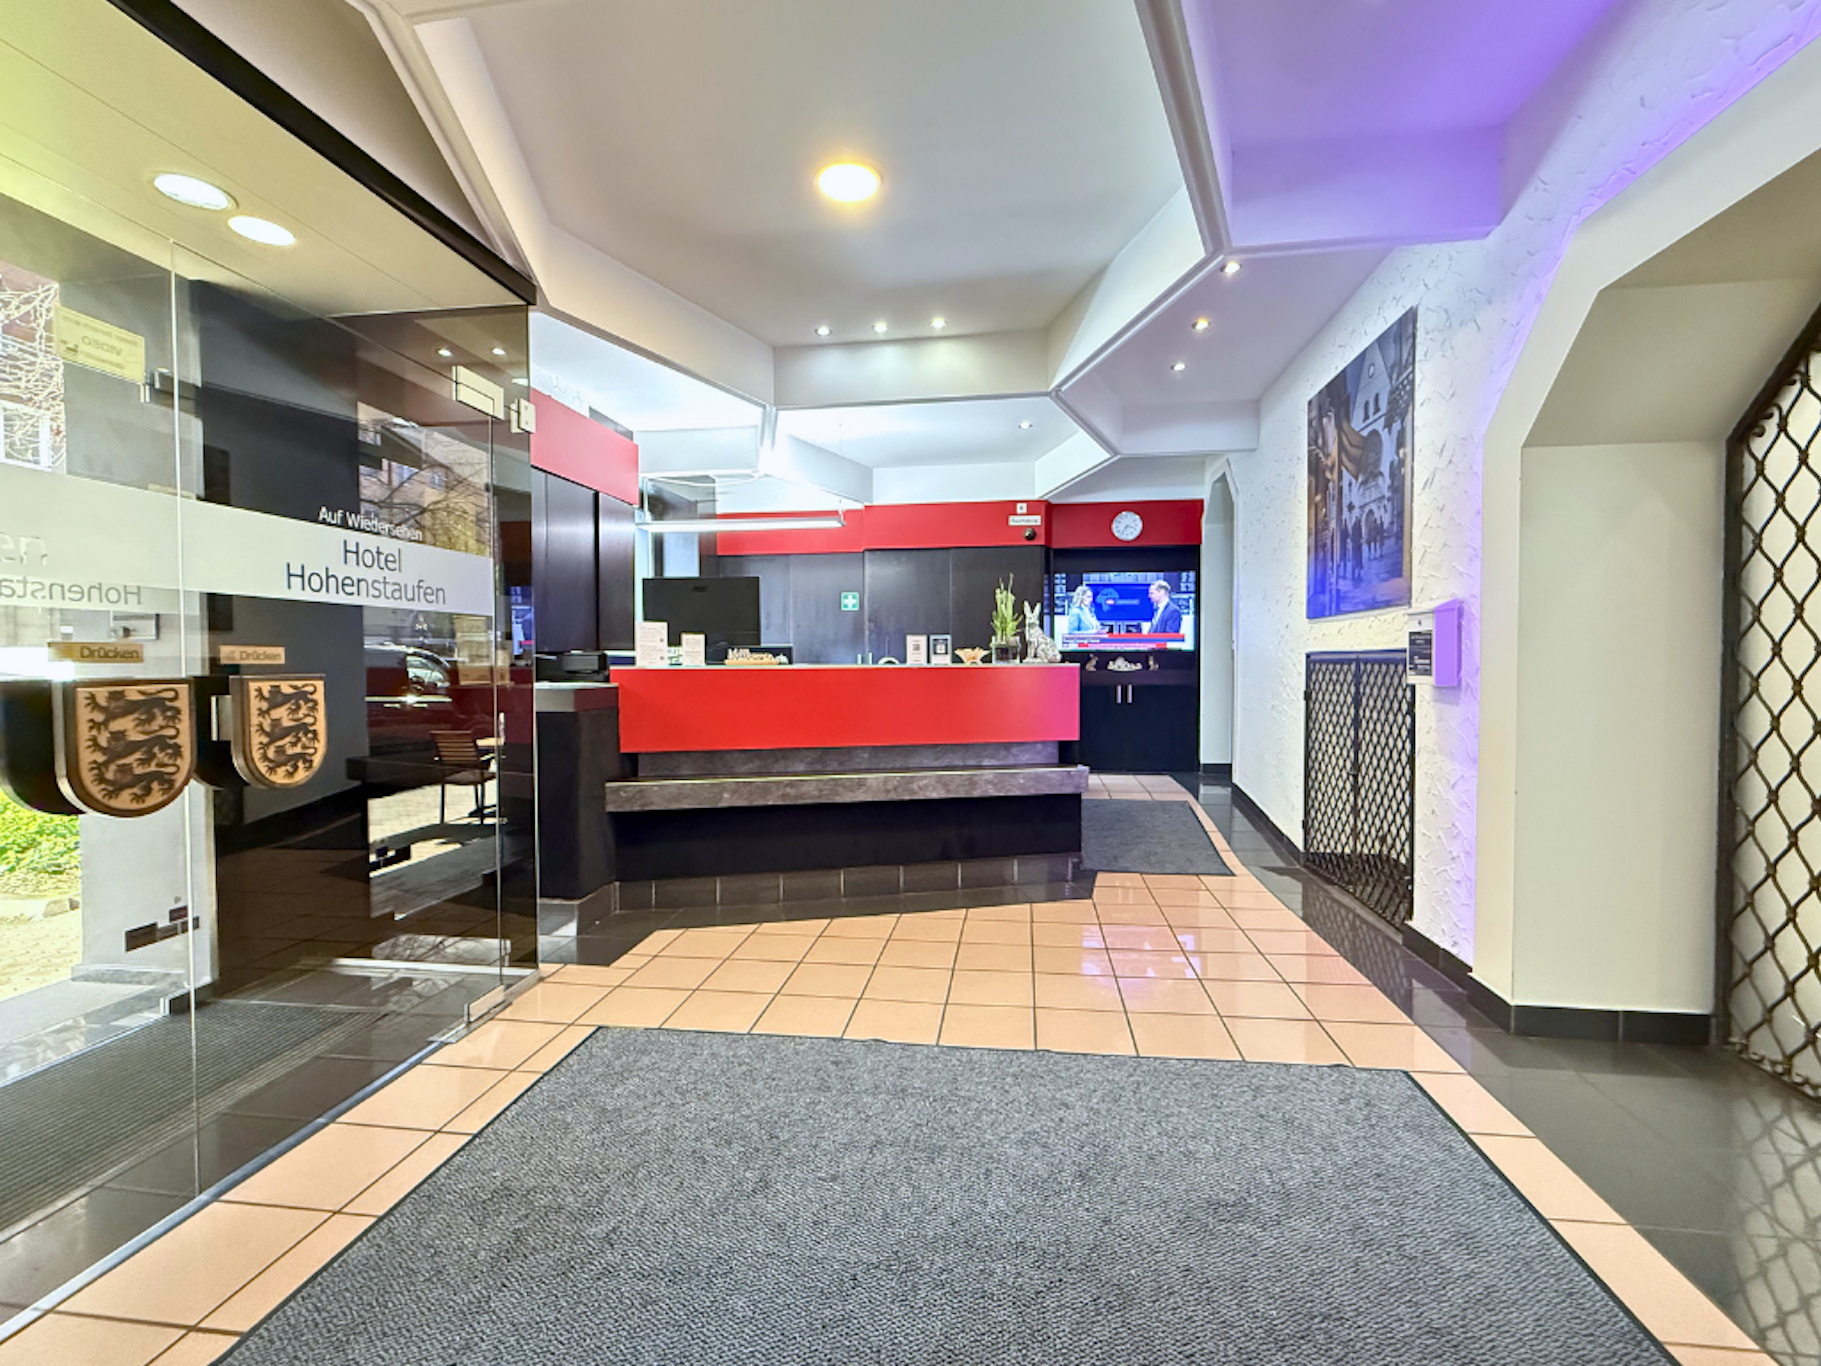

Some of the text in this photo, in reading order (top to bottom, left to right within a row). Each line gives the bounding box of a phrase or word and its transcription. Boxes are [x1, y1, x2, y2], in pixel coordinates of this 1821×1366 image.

[318, 506, 423, 542] Auf Wiedersehen
[343, 538, 402, 573] Hotel
[286, 562, 446, 605] Hohenstaufen
[79, 645, 140, 659] Drücken
[240, 650, 282, 661] Drücken
